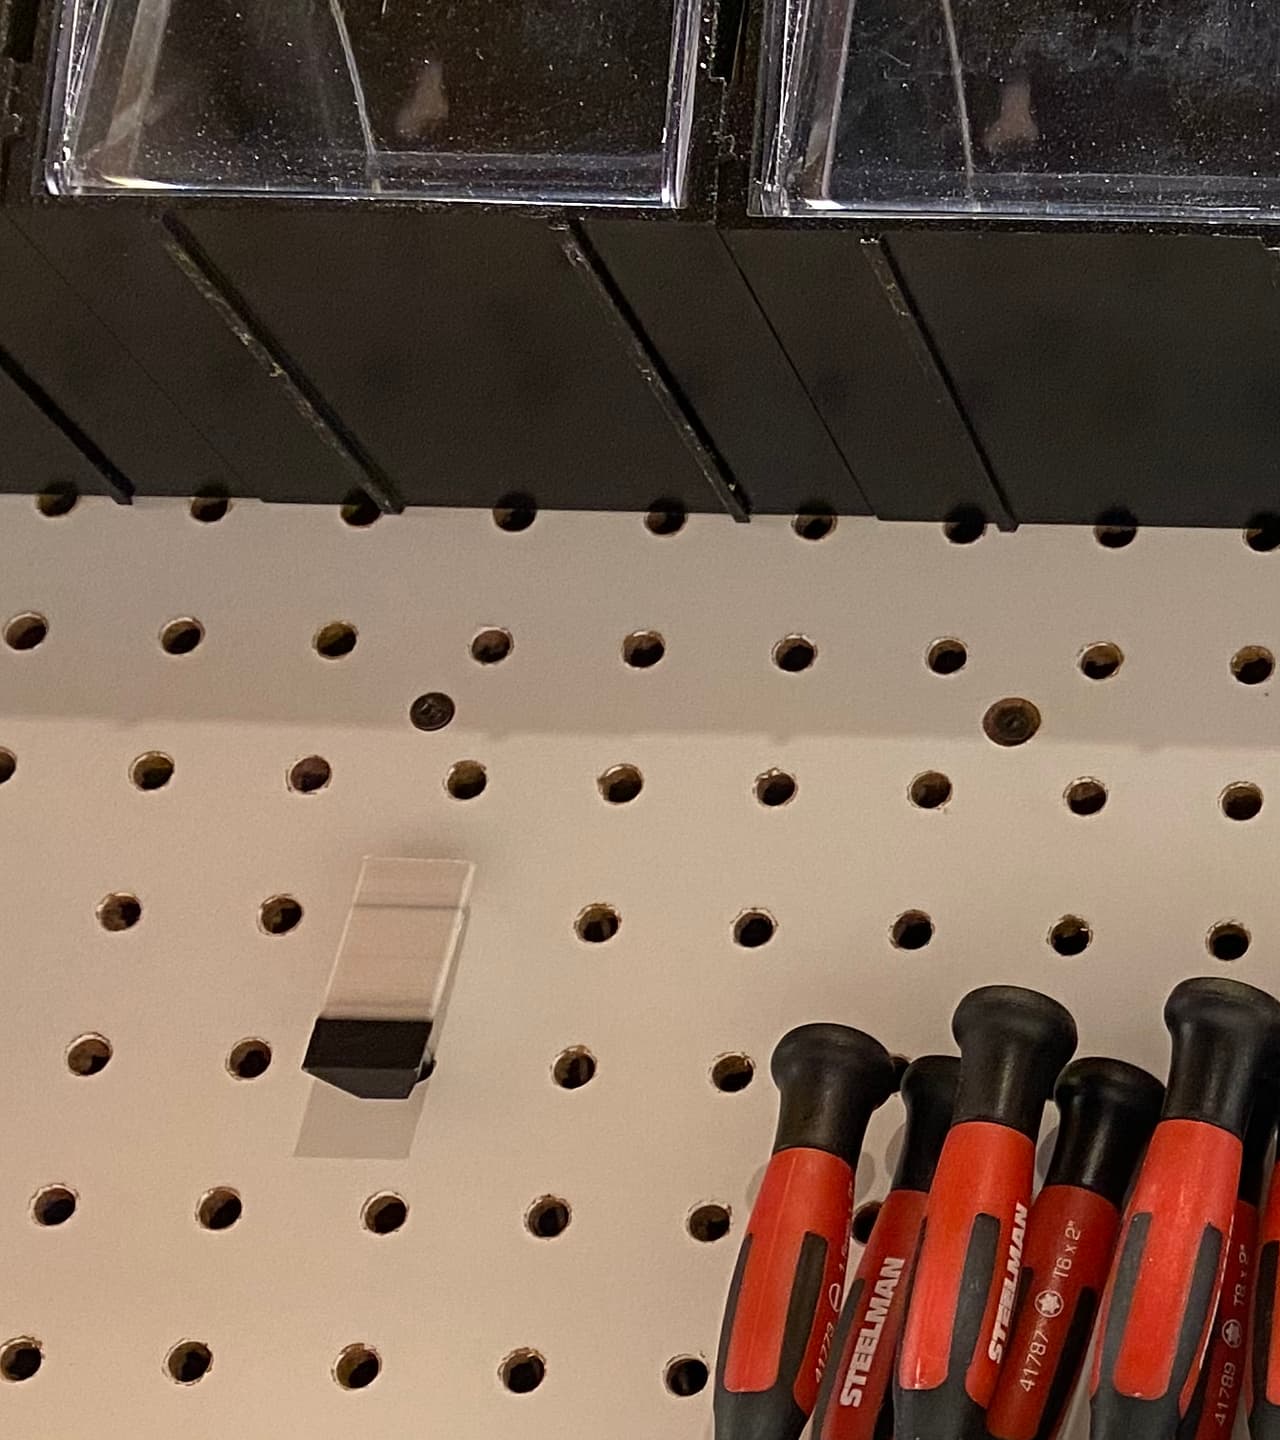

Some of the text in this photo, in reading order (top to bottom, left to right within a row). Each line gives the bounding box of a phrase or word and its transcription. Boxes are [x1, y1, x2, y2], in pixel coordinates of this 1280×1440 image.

[839, 1256, 906, 1408] STEELMAN
[988, 1200, 1029, 1364] STEELMAN
[1019, 1331, 1050, 1393] 41787
[1053, 1257, 1073, 1278] T6
[1064, 1243, 1079, 1255] x
[1214, 1361, 1237, 1427] 41789
